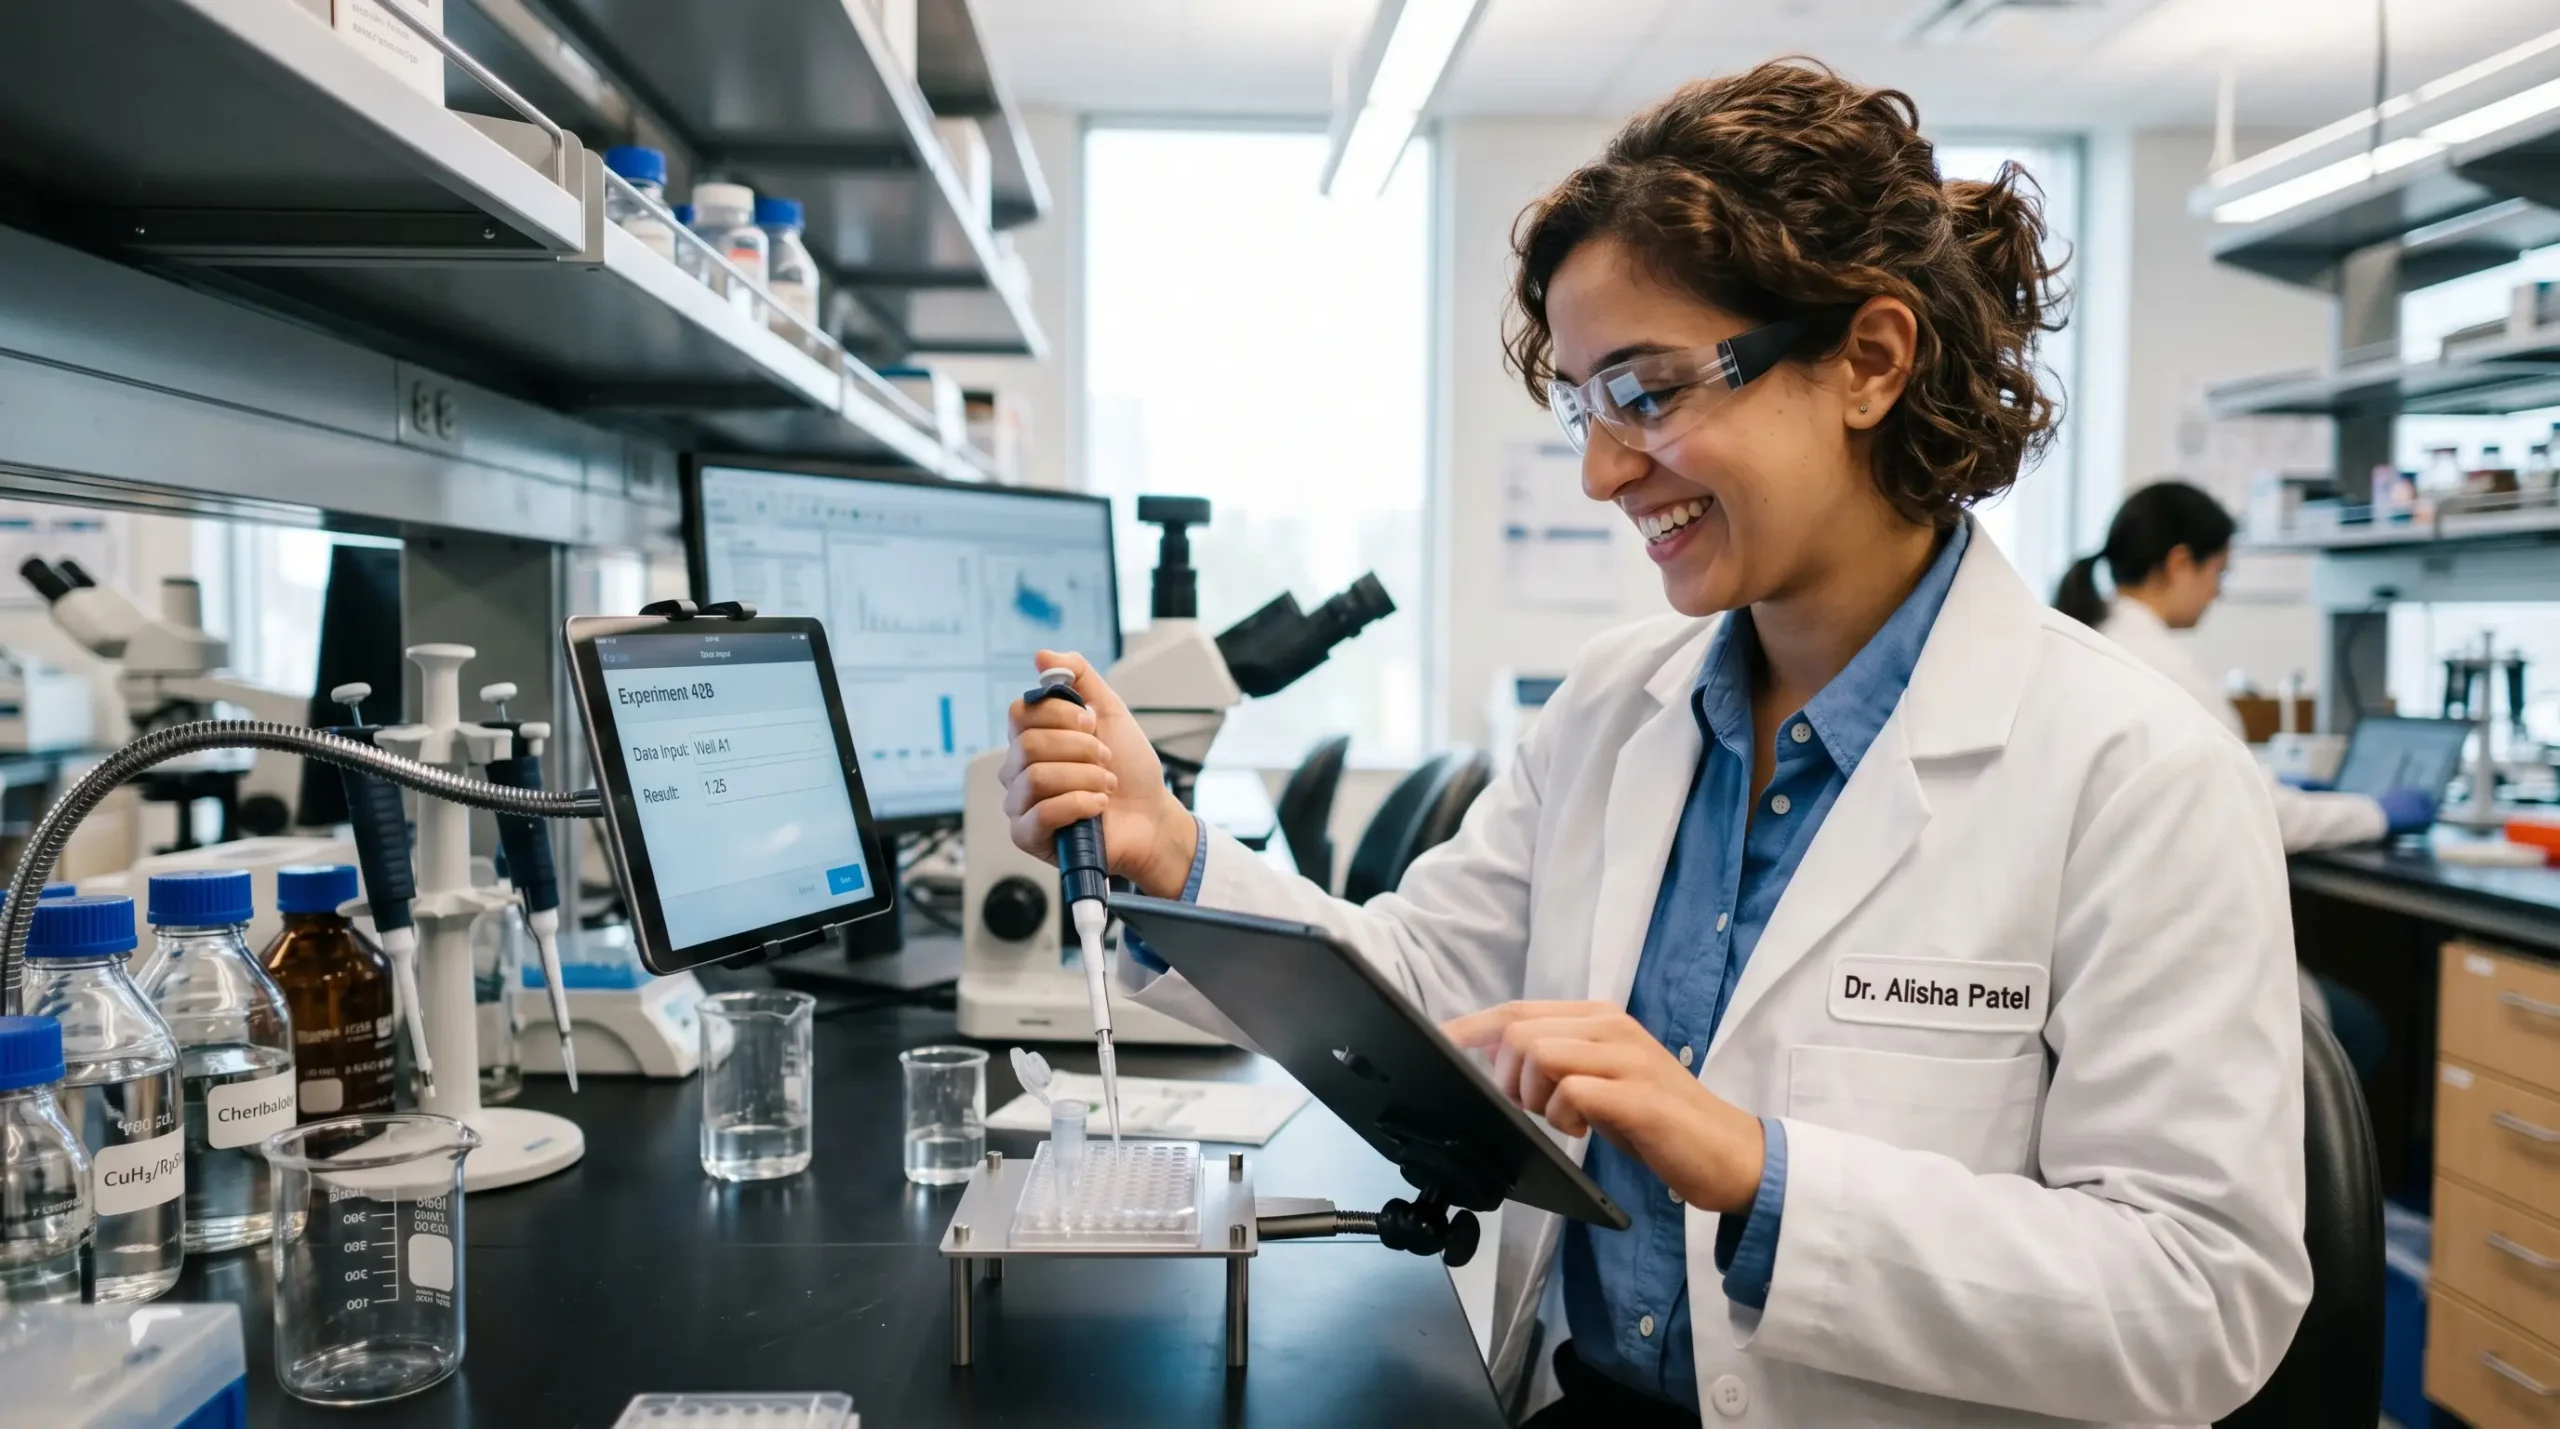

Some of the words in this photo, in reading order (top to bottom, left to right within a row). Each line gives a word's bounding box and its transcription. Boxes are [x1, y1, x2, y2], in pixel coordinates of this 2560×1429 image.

[618, 685, 689, 708] Experiment
[633, 747, 659, 762] Data
[660, 743, 690, 762] Input:
[694, 740, 717, 755] Well
[719, 738, 731, 754] A1
[643, 785, 680, 804] Result:
[705, 778, 727, 795] 1.25
[1844, 975, 1876, 1000] Dr.
[1884, 977, 1959, 1007] Alisha
[1968, 984, 2031, 1010] Patel
